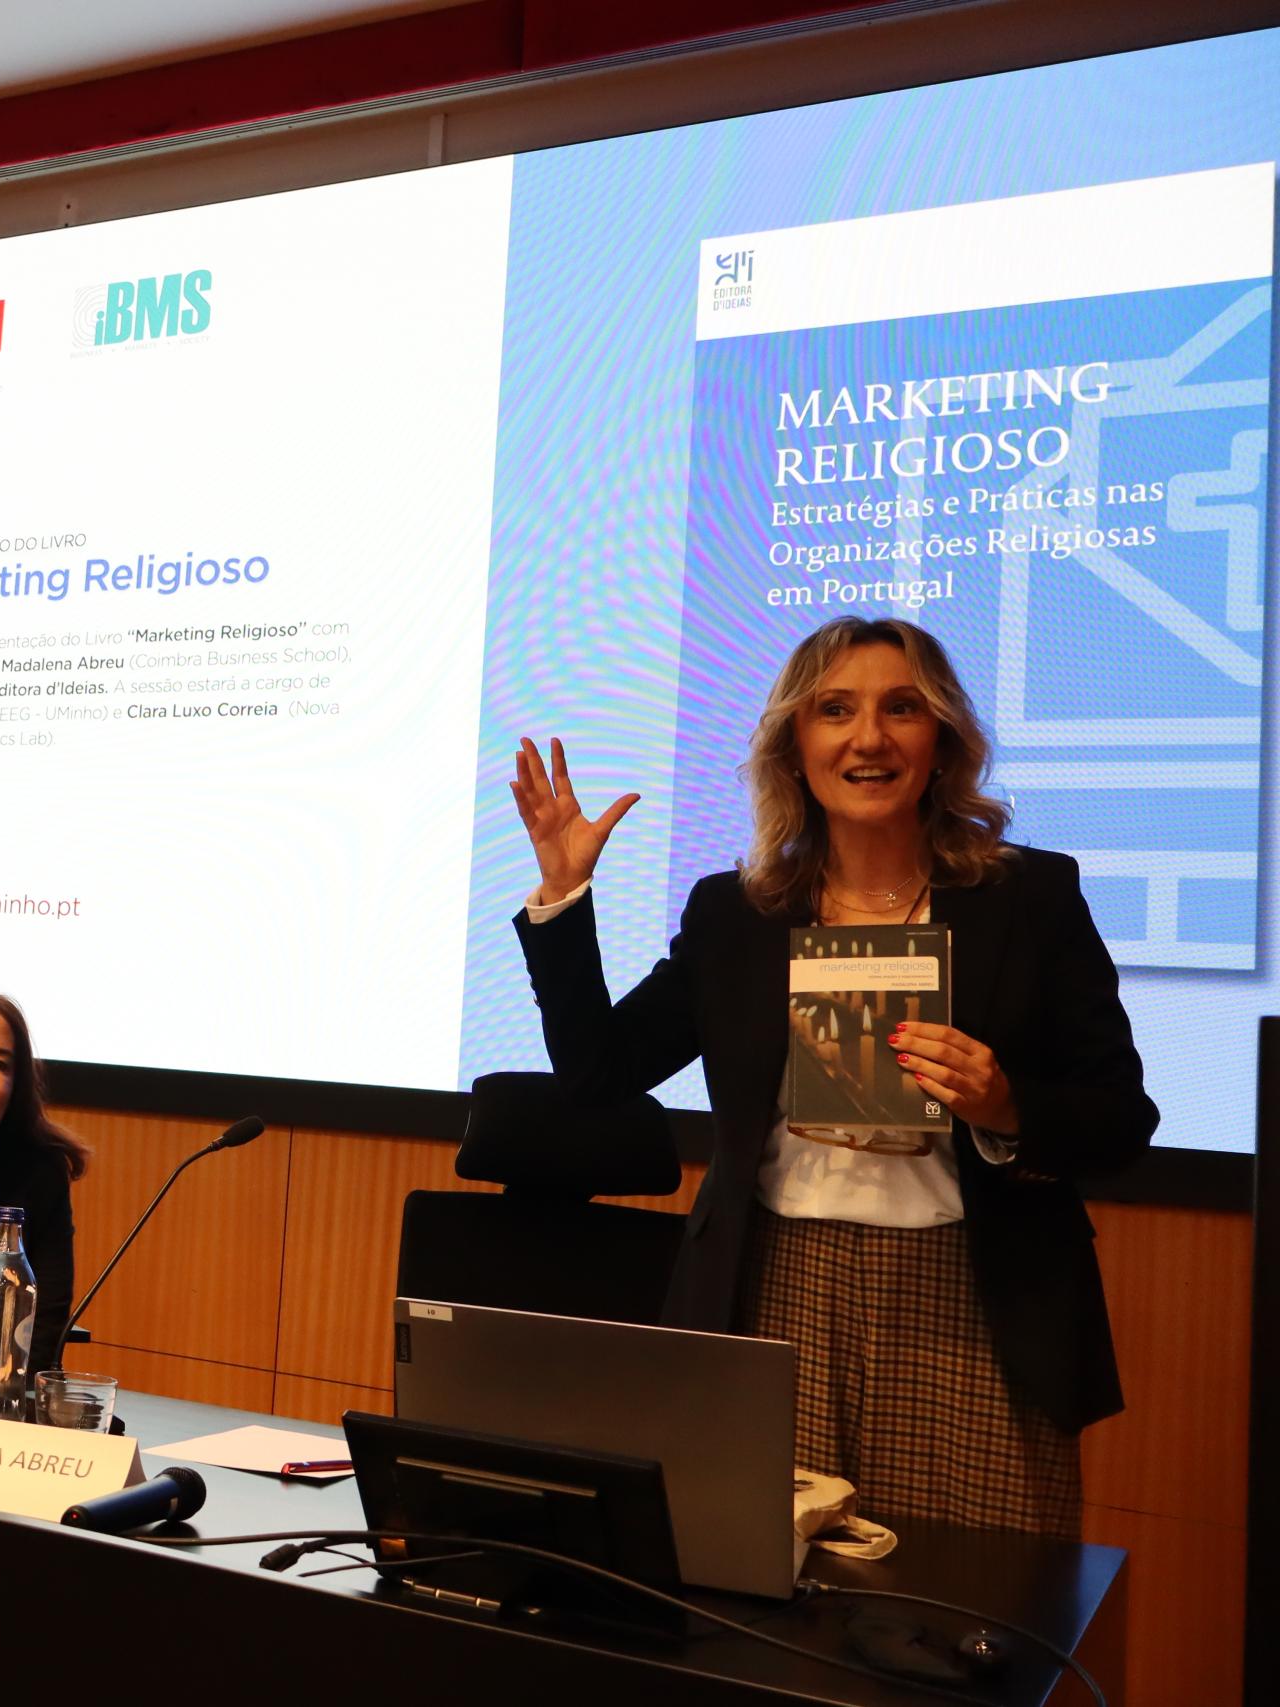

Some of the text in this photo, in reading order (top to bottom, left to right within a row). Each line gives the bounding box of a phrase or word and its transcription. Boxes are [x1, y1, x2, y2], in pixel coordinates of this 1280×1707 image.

[714, 285, 752, 299] EDITORA
[94, 269, 212, 346] iBMS
[776, 360, 1113, 431] MARKETING
[774, 425, 1071, 487] RELIGIOSO
[771, 480, 1165, 528] Estratégias e Práticas nas
[15, 536, 38, 551] DO
[41, 533, 87, 550] LIVRO
[768, 520, 1157, 573] Organizações Religiosas
[84, 552, 270, 595] Religioso
[766, 572, 955, 608] em Portugal
[61, 631, 81, 647] do
[85, 631, 123, 646] Livro
[312, 622, 350, 636] com
[1, 657, 72, 673] Madalena
[77, 655, 124, 670] Abreu
[129, 651, 202, 671] (Coimbra
[208, 649, 278, 666] Business
[46, 680, 108, 695] d'Ideias.
[114, 680, 126, 694] A
[130, 678, 183, 694] sessão
[187, 675, 236, 692] estará
[241, 678, 251, 690] a
[256, 676, 303, 693] cargo
[309, 673, 331, 689] de
[45, 705, 108, 722] UMinho)
[113, 709, 122, 720] e
[127, 704, 167, 719] Clara
[172, 703, 212, 718] Luxo
[217, 701, 278, 717] Correia
[289, 700, 340, 718] (Nova
[820, 960, 934, 974] marketing religioso
[8, 1450, 94, 1479] ABREU
